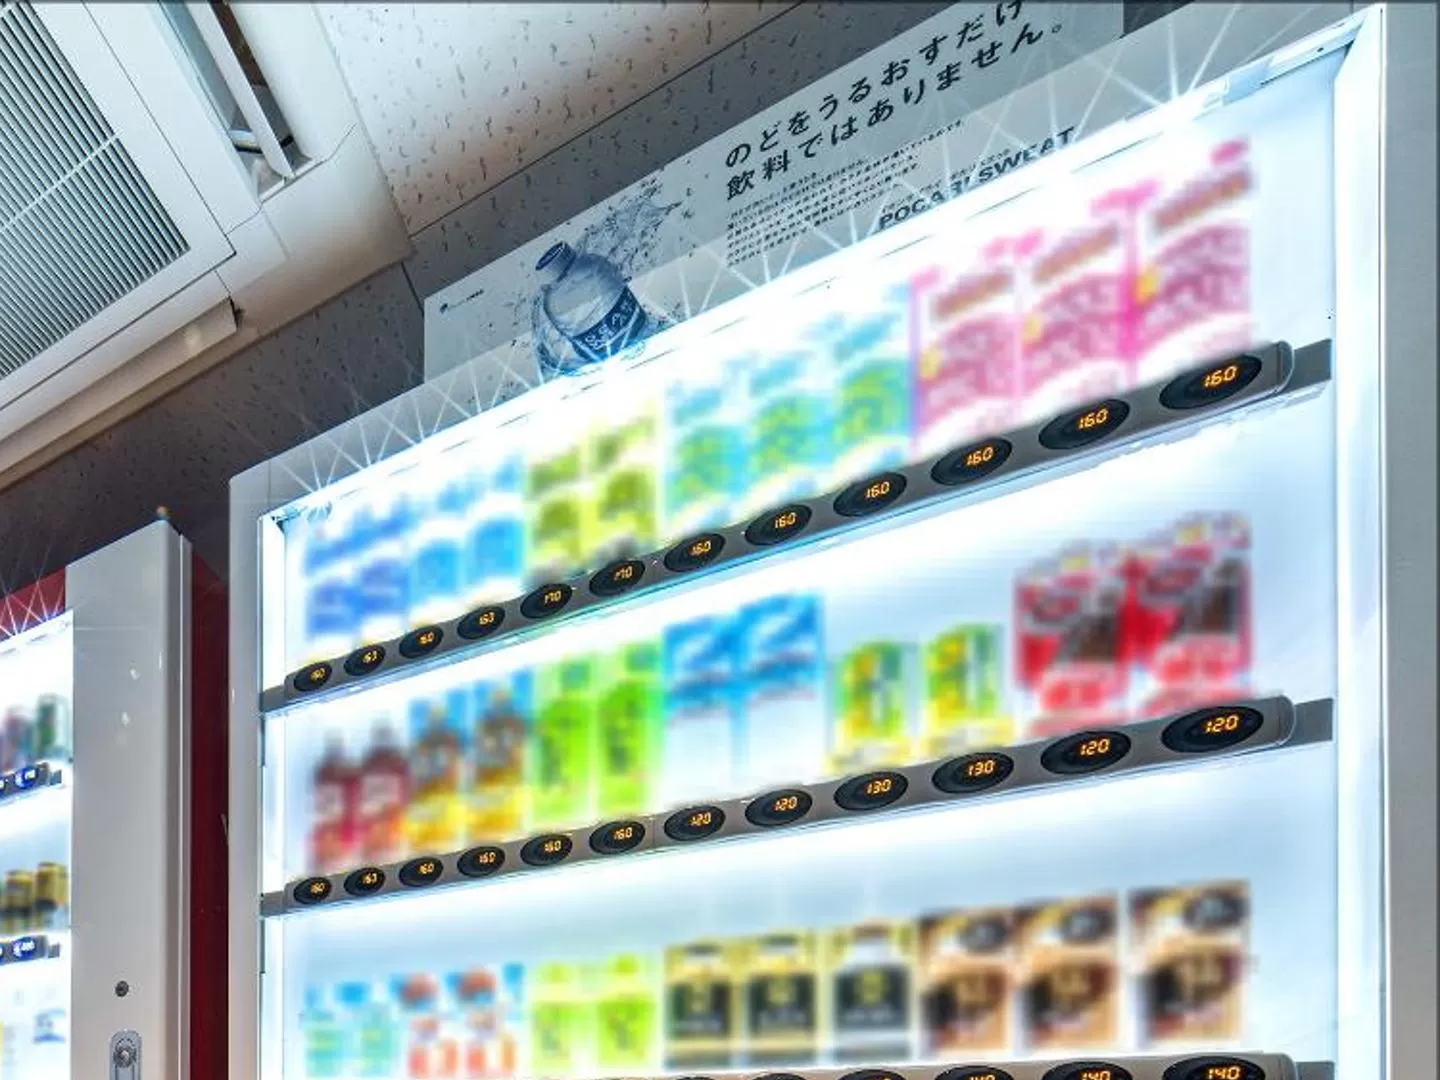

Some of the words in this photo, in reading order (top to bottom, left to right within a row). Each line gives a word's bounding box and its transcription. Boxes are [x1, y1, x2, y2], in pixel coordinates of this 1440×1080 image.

[726, 23, 1062, 201] 飲料ではありません。
[978, 125, 1075, 184] SWEAT
[1205, 365, 1239, 389] 160
[1079, 408, 1110, 430] 160
[966, 446, 995, 467] 160
[865, 481, 891, 499] 160
[774, 512, 797, 530] 160
[1206, 714, 1240, 734] 120
[1081, 738, 1112, 757] 120
[969, 760, 996, 778] 130
[867, 779, 893, 795] 130
[774, 796, 799, 812] 120
